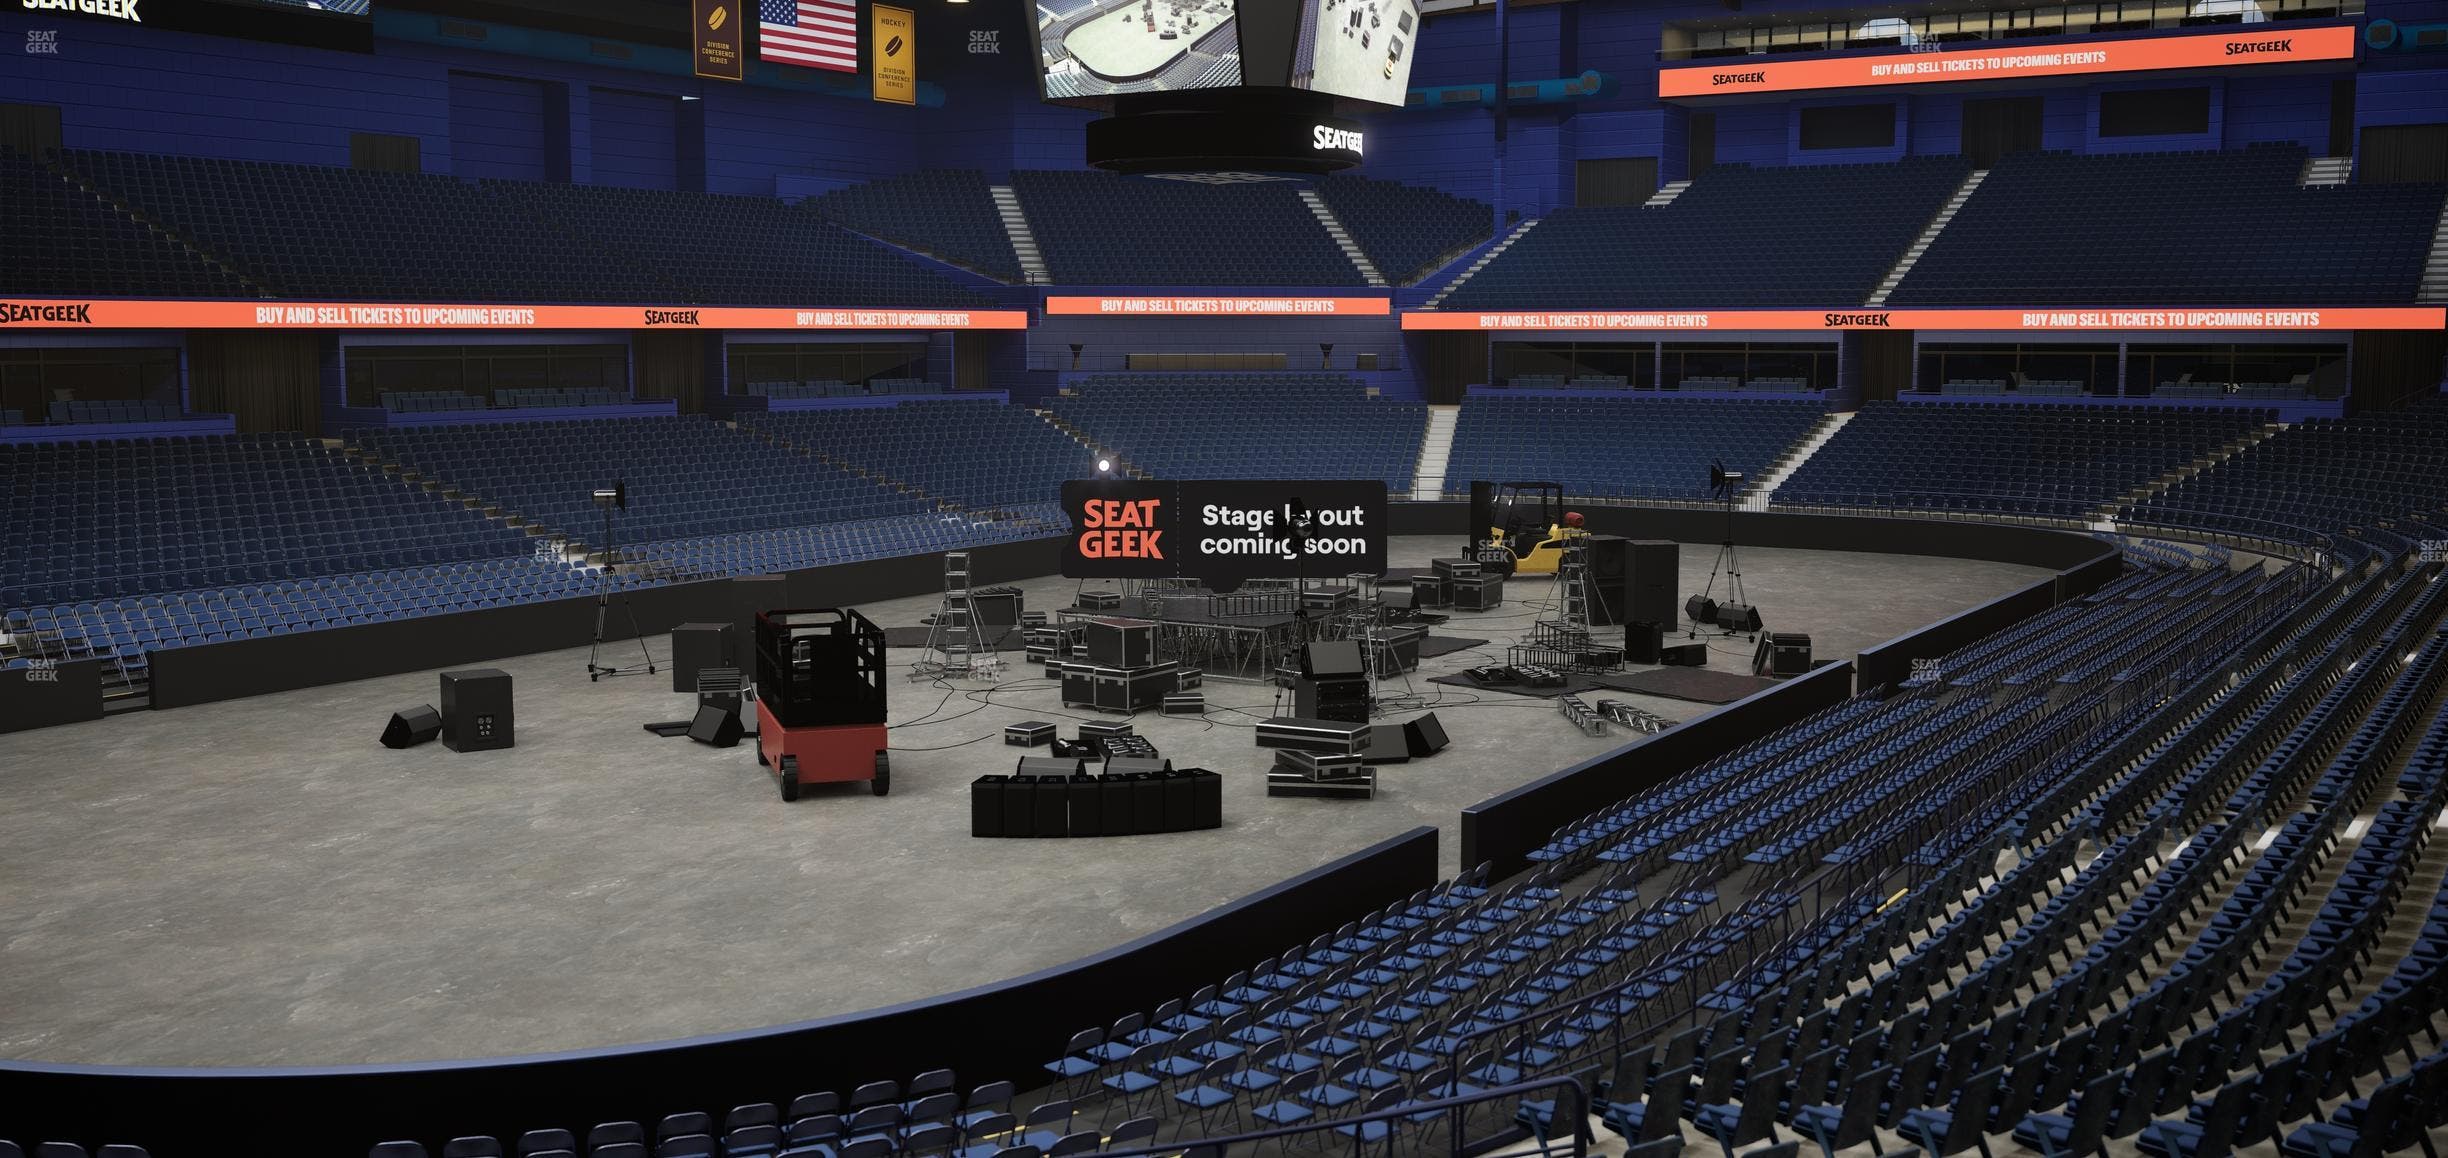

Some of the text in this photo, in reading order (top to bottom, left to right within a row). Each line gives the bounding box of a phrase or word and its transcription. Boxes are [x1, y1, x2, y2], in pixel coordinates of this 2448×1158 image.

[880, 17, 906, 28] HOCKEY
[702, 47, 735, 58] CONFERENCE
[706, 40, 730, 50] DIVISION
[2225, 39, 2292, 55] SEATGEEK
[709, 56, 728, 65] SERIES
[1872, 51, 2106, 76] BUY AND SELL TICKETS TO UPCOMING EVENTS
[878, 72, 911, 82] CONFERENCE
[883, 66, 905, 75] DIVISION
[886, 80, 904, 89] SERIES
[1712, 71, 1766, 86] SEATGEEK
[1102, 300, 1335, 313] BUY AND SELL TICKETS TO UPCOMING EVENTS
[256, 307, 535, 325] BUY AND SELL TICKETS TO UPCOMING EVENTS
[644, 310, 700, 326] SEATGEEK
[797, 312, 970, 327] BUY AND SELL TICKETS TO UPCOMING EVENTS
[1480, 315, 1708, 327] BUY AND SELL TICKETS TO UPCOMING EVENTS
[1825, 313, 1890, 327] SEATGEEK
[2022, 312, 2320, 327] BUY AND SELL TICKETS TO UPCOMING EVENTS
[1084, 499, 1161, 528] SEAT
[1202, 503, 1364, 532] Stage lout
[1079, 530, 1164, 560] GEEK
[1304, 538, 1366, 554] soon
